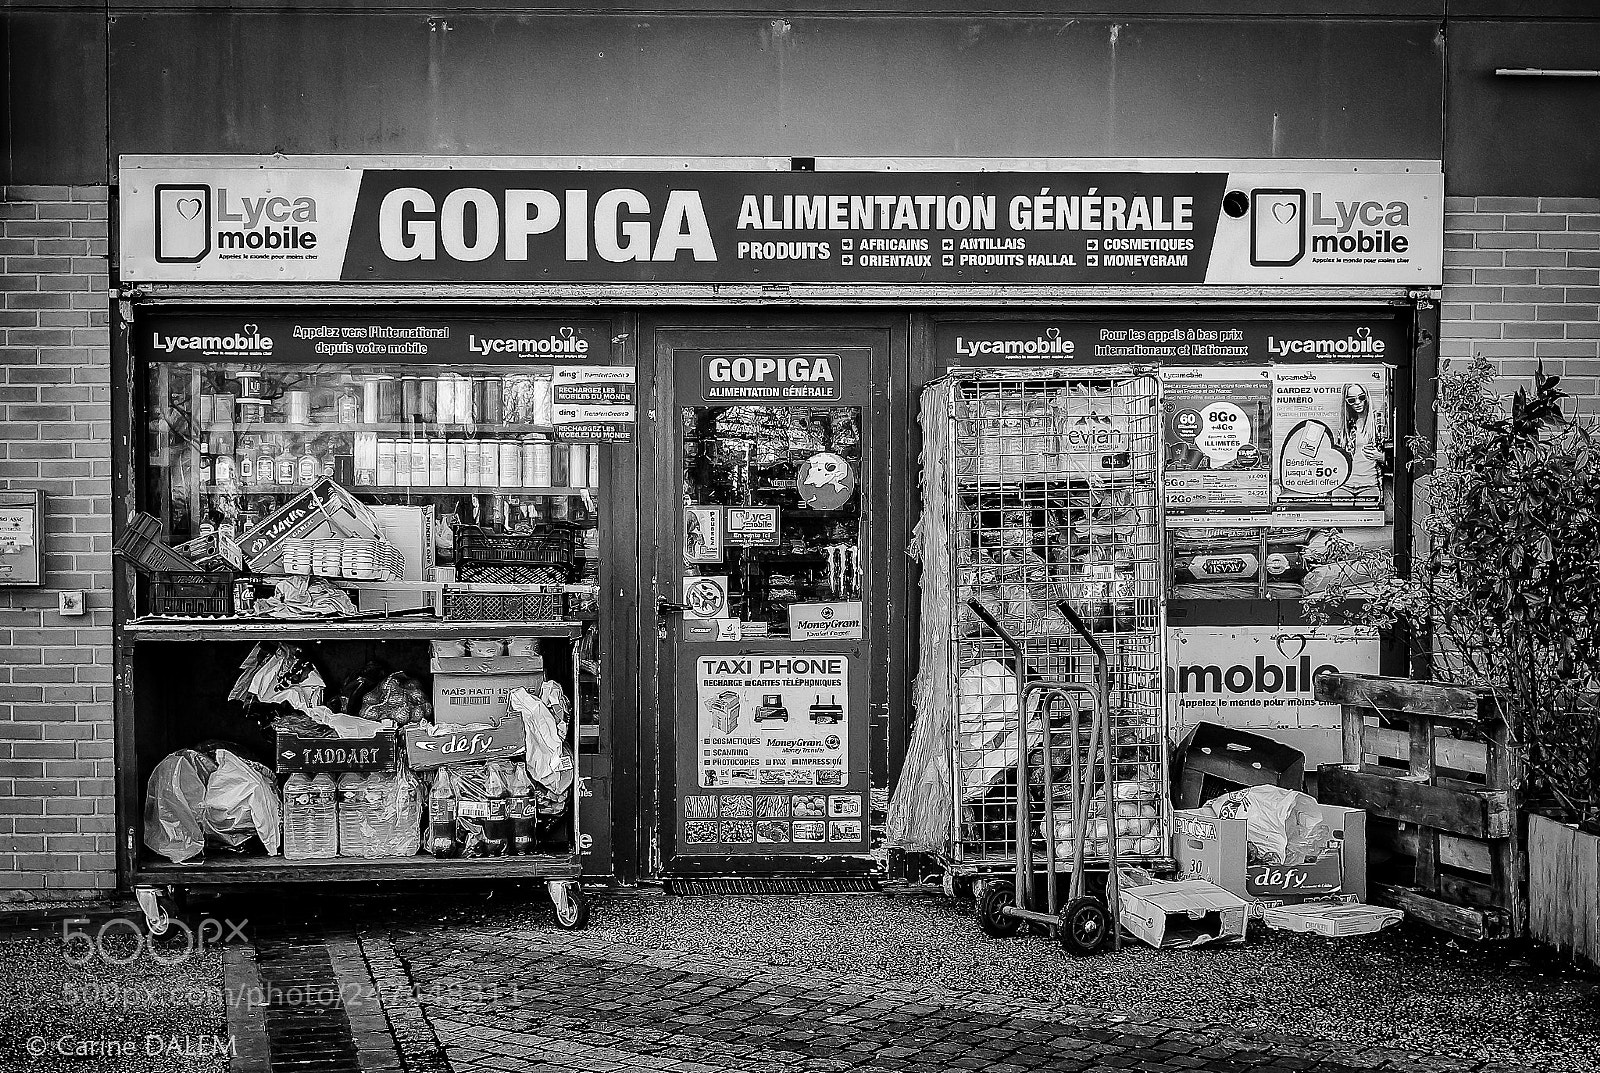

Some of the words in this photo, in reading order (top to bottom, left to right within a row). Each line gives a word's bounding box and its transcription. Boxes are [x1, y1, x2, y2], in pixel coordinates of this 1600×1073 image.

[217, 188, 318, 230] Lyca
[737, 194, 996, 230] ALIMENTATION
[1009, 187, 1194, 231] GÉNÉRALE
[1312, 192, 1410, 233] Lyca
[379, 187, 718, 262] GOPIGA
[218, 226, 317, 249] mobile
[959, 238, 1026, 250] ANTILLAIS
[1312, 230, 1409, 253] mobile
[737, 242, 831, 260] PRODUITS
[859, 239, 929, 251] AFRICAINS
[1103, 239, 1194, 251] COSMETIQUES
[859, 255, 932, 267] ORIENTAUX
[959, 255, 1024, 267] PRODUITS
[1028, 255, 1077, 267] HALLAL
[1103, 255, 1188, 267] MONEYGRAM
[293, 326, 339, 339] Appelez
[342, 328, 367, 337] vers
[1101, 329, 1126, 340] Pour
[1129, 329, 1145, 340] les
[1148, 329, 1185, 341] appels
[1187, 329, 1195, 340] à
[1197, 329, 1217, 340] bas
[1220, 329, 1243, 341] prix
[153, 332, 273, 352] Lycamobile
[315, 342, 353, 355] depuis
[356, 343, 386, 353] votre
[388, 342, 427, 354] mobile
[469, 335, 589, 355] Lycamobile
[956, 337, 1075, 358] Lycamobile
[1268, 336, 1385, 356] Lycamobile
[1095, 345, 1176, 356] Internationaux
[1178, 345, 1189, 355] et
[1192, 345, 1248, 356] Nationaux
[559, 370, 576, 379] ding
[708, 358, 834, 382] GOPIGA
[709, 387, 779, 397] ALIMENTATION
[783, 384, 833, 397] GÉNÉRALE
[559, 409, 575, 417] ding
[1180, 414, 1196, 424] 60
[1209, 412, 1237, 422] 8Go
[798, 620, 860, 630] MoneyGram
[703, 660, 752, 675] TAXI
[759, 660, 842, 675] PHONE
[1179, 698, 1216, 708] Appelez
[1263, 699, 1285, 707] pour
[441, 733, 493, 755] défy
[302, 748, 379, 764] TADDART
[1190, 859, 1202, 873] 30
[1254, 866, 1308, 890] défy
